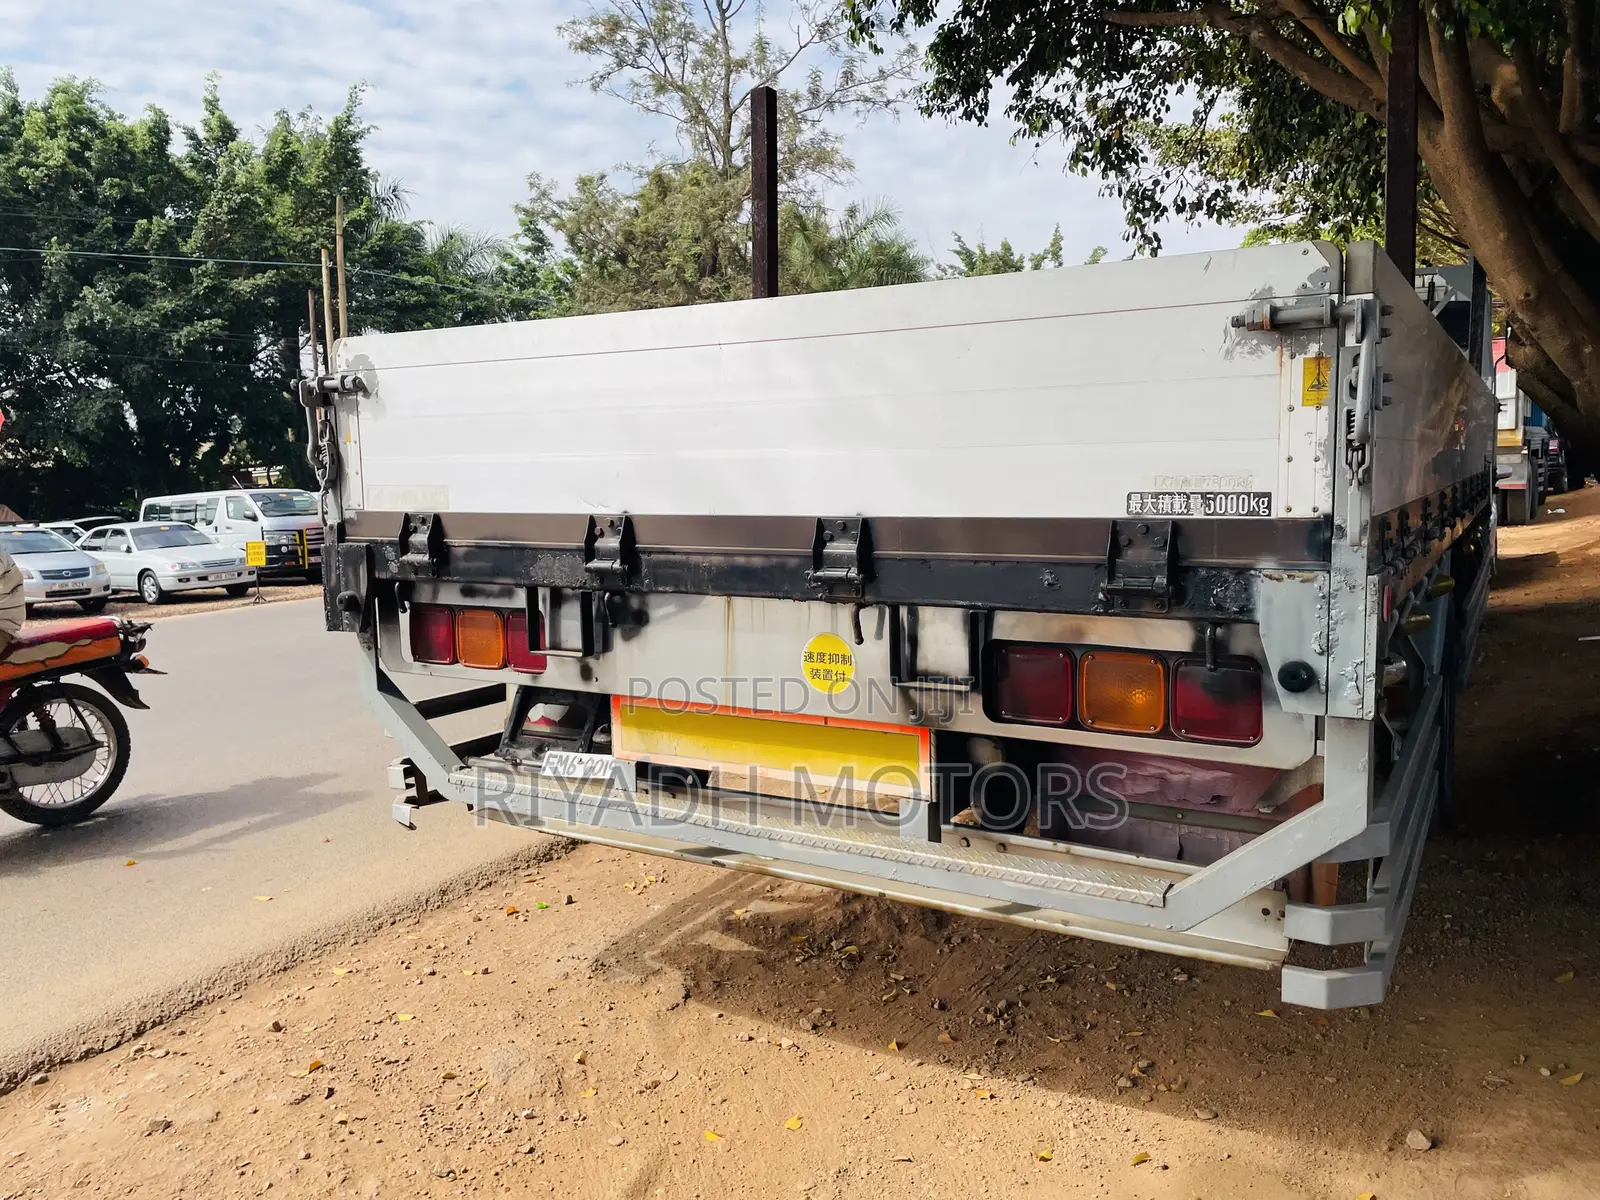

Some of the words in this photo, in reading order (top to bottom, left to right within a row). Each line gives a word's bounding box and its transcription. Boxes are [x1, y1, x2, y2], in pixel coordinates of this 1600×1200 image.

[1128, 493, 1269, 516] 最大積載量5000kg
[803, 651, 853, 666] 速度抑制
[809, 667, 847, 682] 装置付
